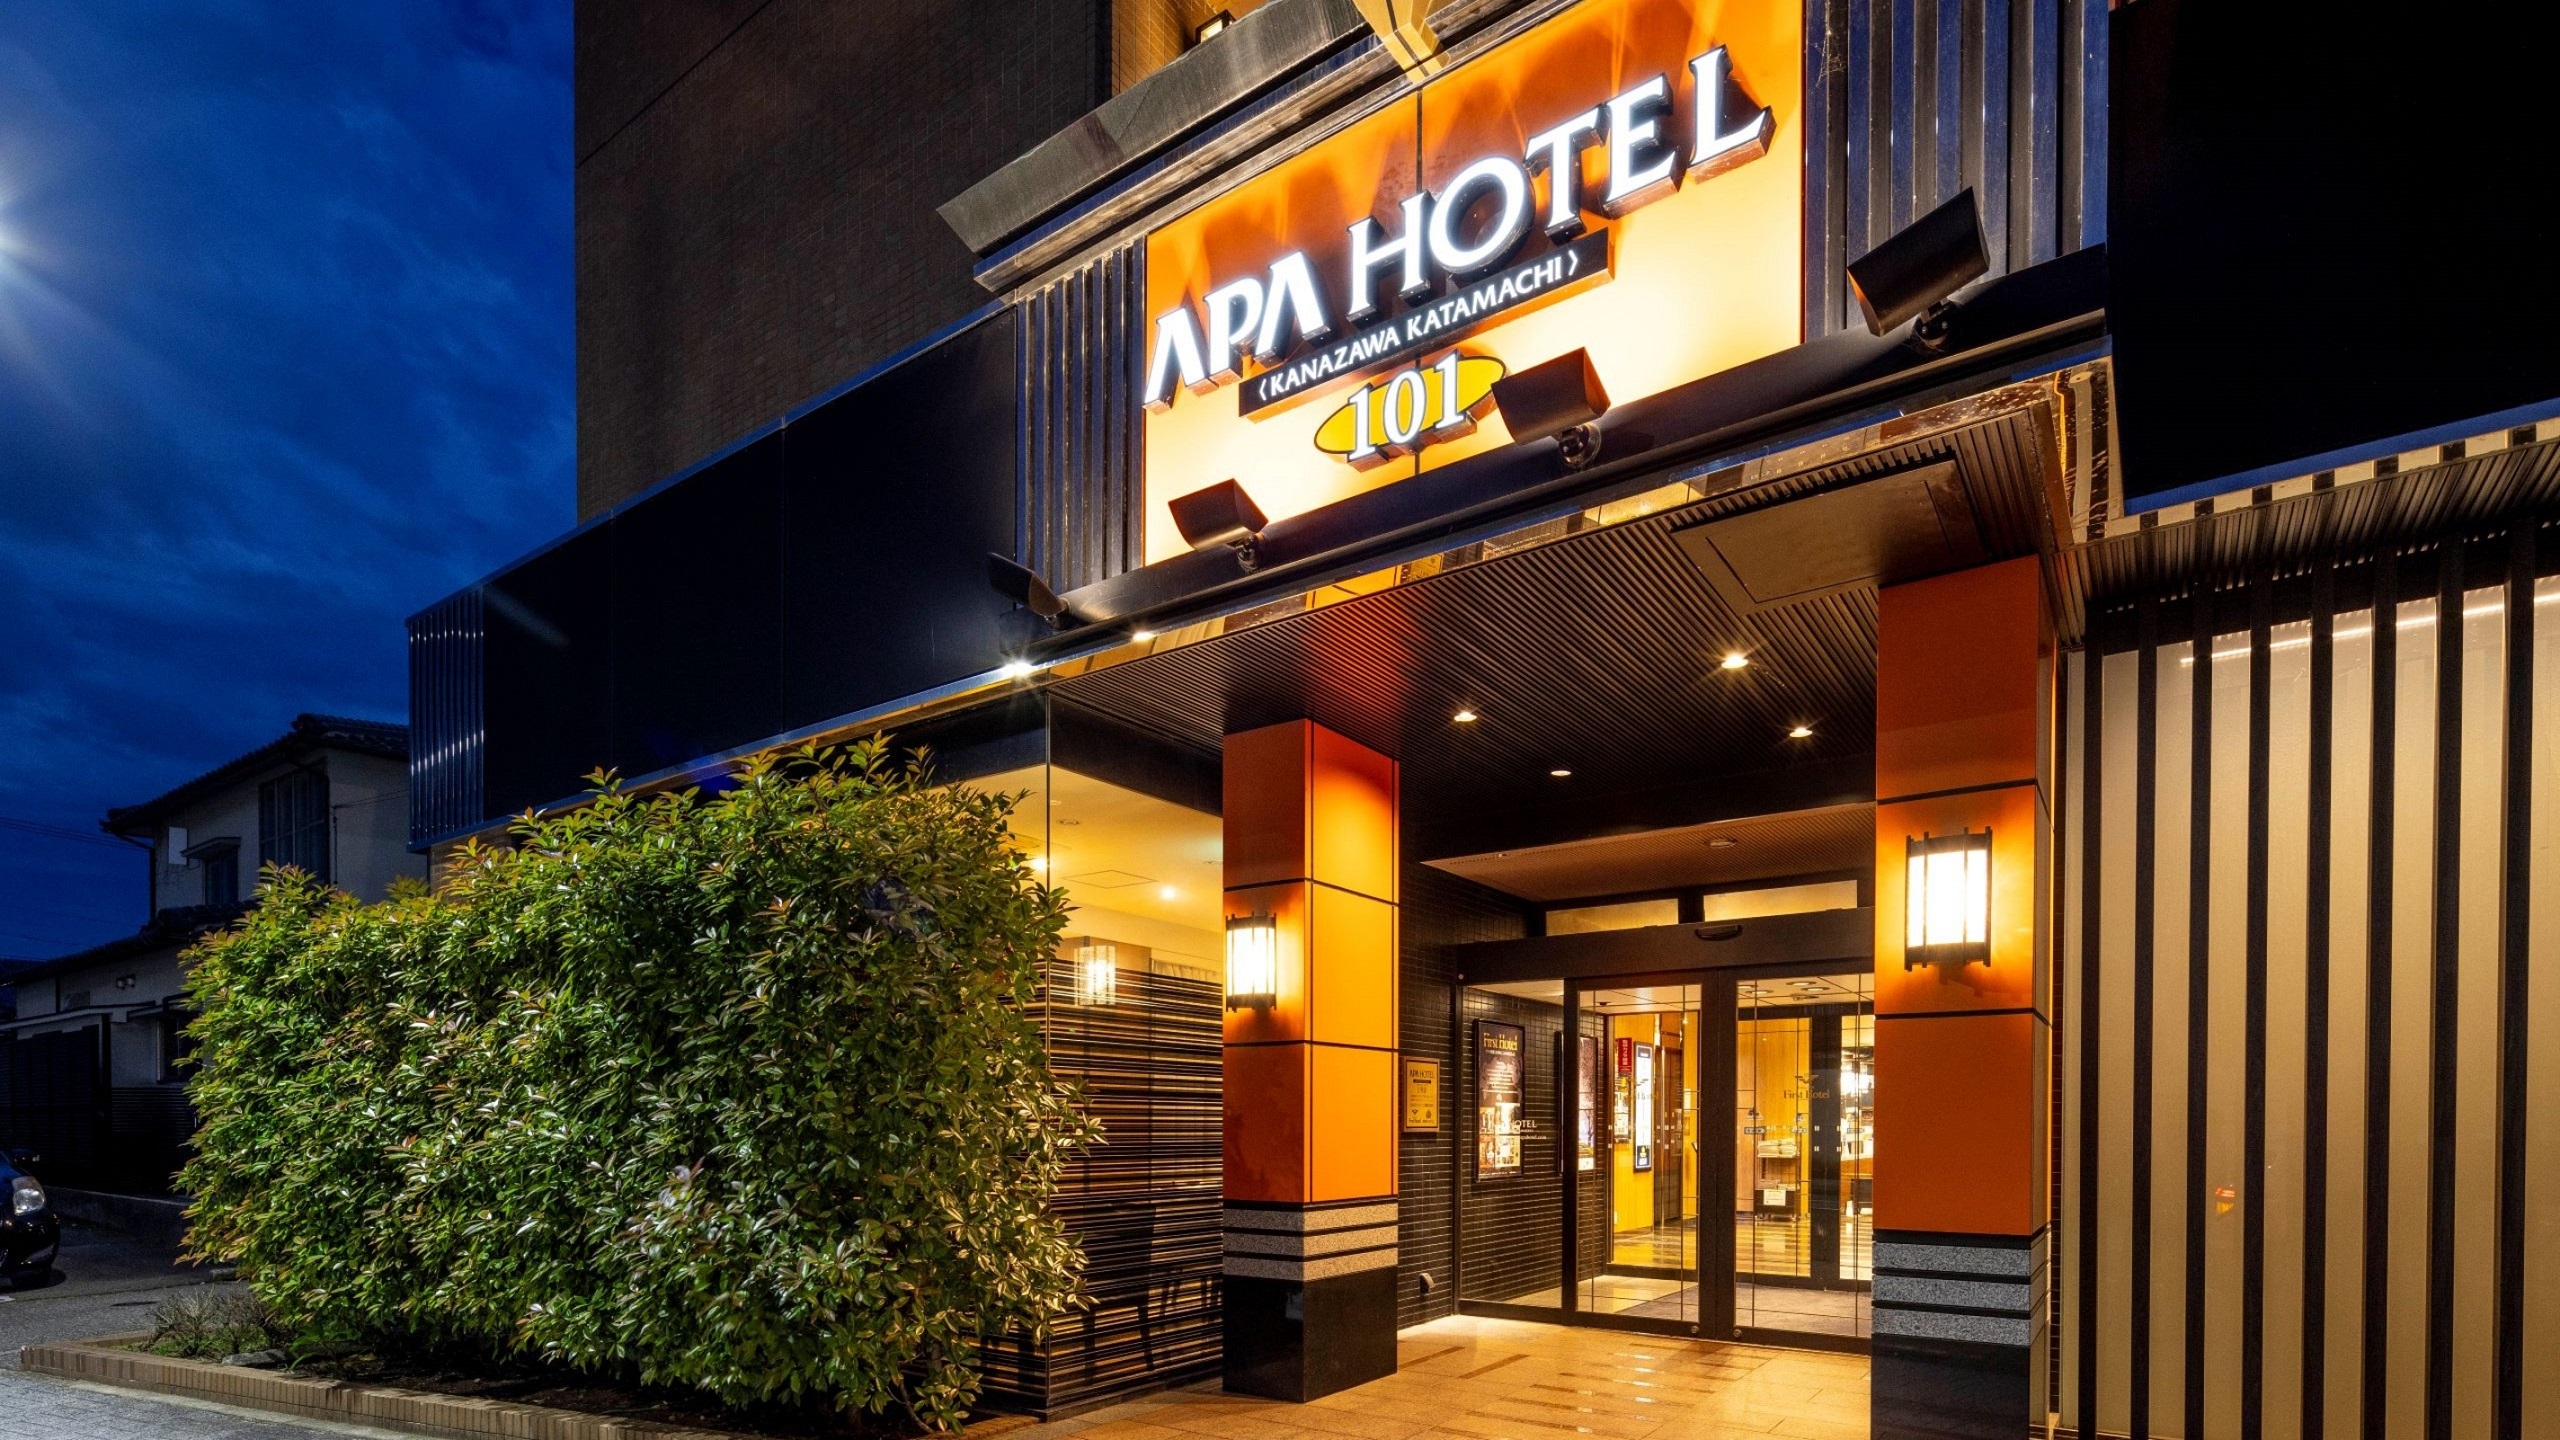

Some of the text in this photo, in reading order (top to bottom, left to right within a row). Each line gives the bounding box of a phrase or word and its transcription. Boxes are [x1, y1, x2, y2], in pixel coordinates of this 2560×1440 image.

[1143, 44, 1771, 407] APA HOTEL
[1346, 349, 1466, 462] 101
